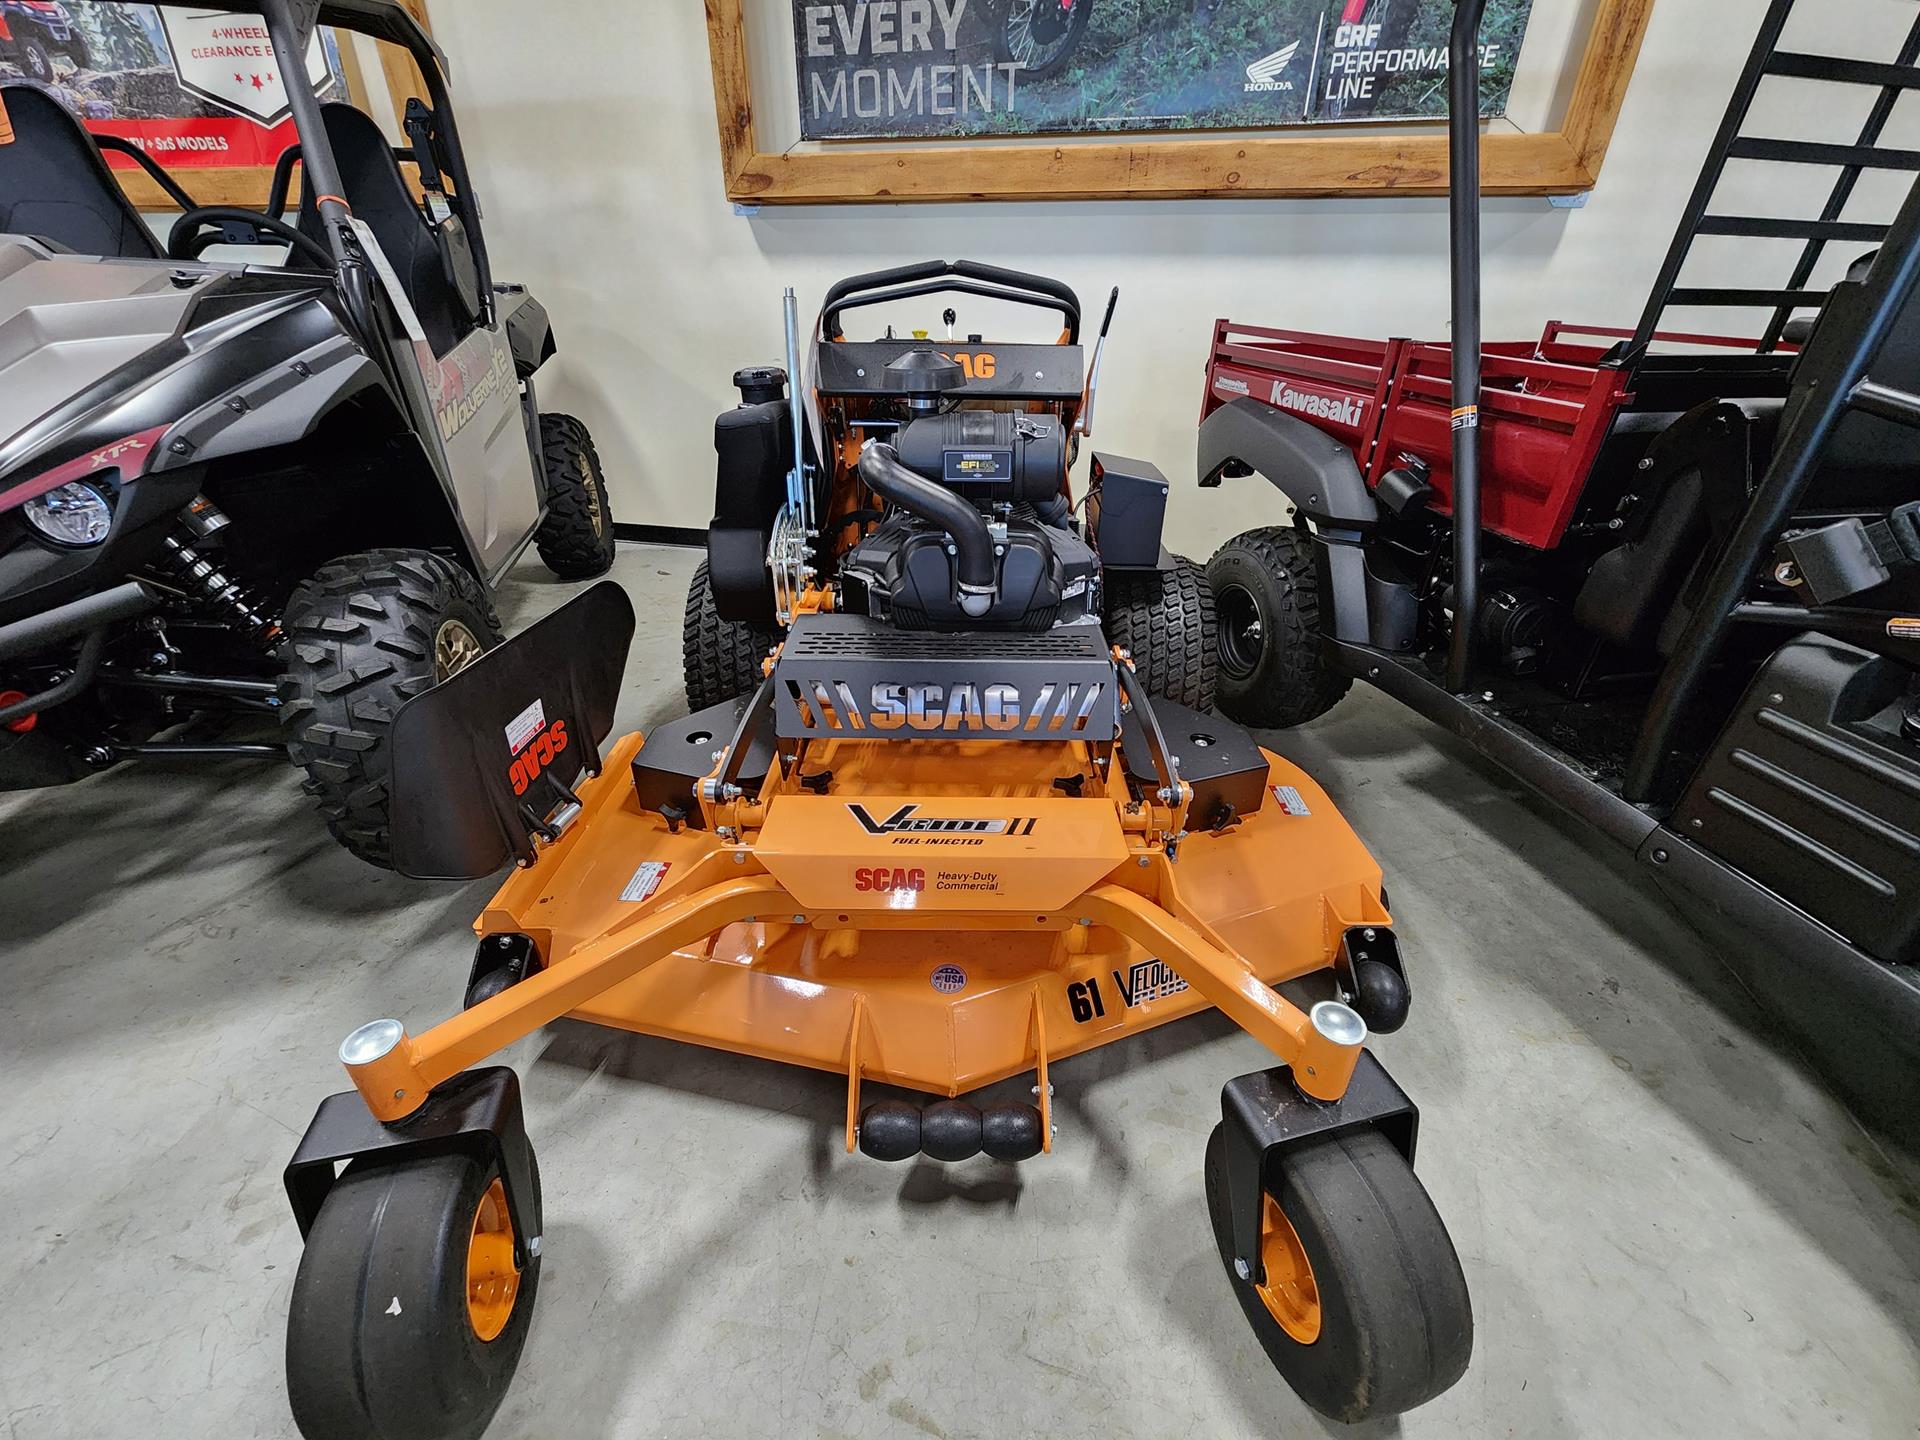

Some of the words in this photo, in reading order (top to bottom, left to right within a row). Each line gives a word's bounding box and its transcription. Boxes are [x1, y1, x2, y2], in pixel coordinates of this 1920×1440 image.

[211, 27, 270, 39] 4-WHEEL
[805, 0, 968, 57] EVERY
[1334, 24, 1382, 48] CRF
[191, 45, 263, 59] CLEARANCE
[1330, 44, 1500, 75] PERFORMAE
[811, 61, 1027, 120] MOMENT
[1244, 81, 1293, 92] HONDA
[1325, 77, 1376, 101] LINE
[176, 136, 229, 151] MODELS
[940, 352, 996, 379] AG
[1270, 381, 1364, 427] Kawasaki
[870, 681, 1020, 731] SCAG
[509, 719, 569, 796] SCAG
[891, 837, 984, 847] FUEL-INJECTED
[855, 867, 926, 892] SCAG
[936, 881, 999, 891] Commercial
[937, 871, 998, 882] Heavy-Duty
[944, 974, 964, 985] USA
[1111, 957, 1181, 1009] VELOCI
[1066, 977, 1106, 1025] 61
